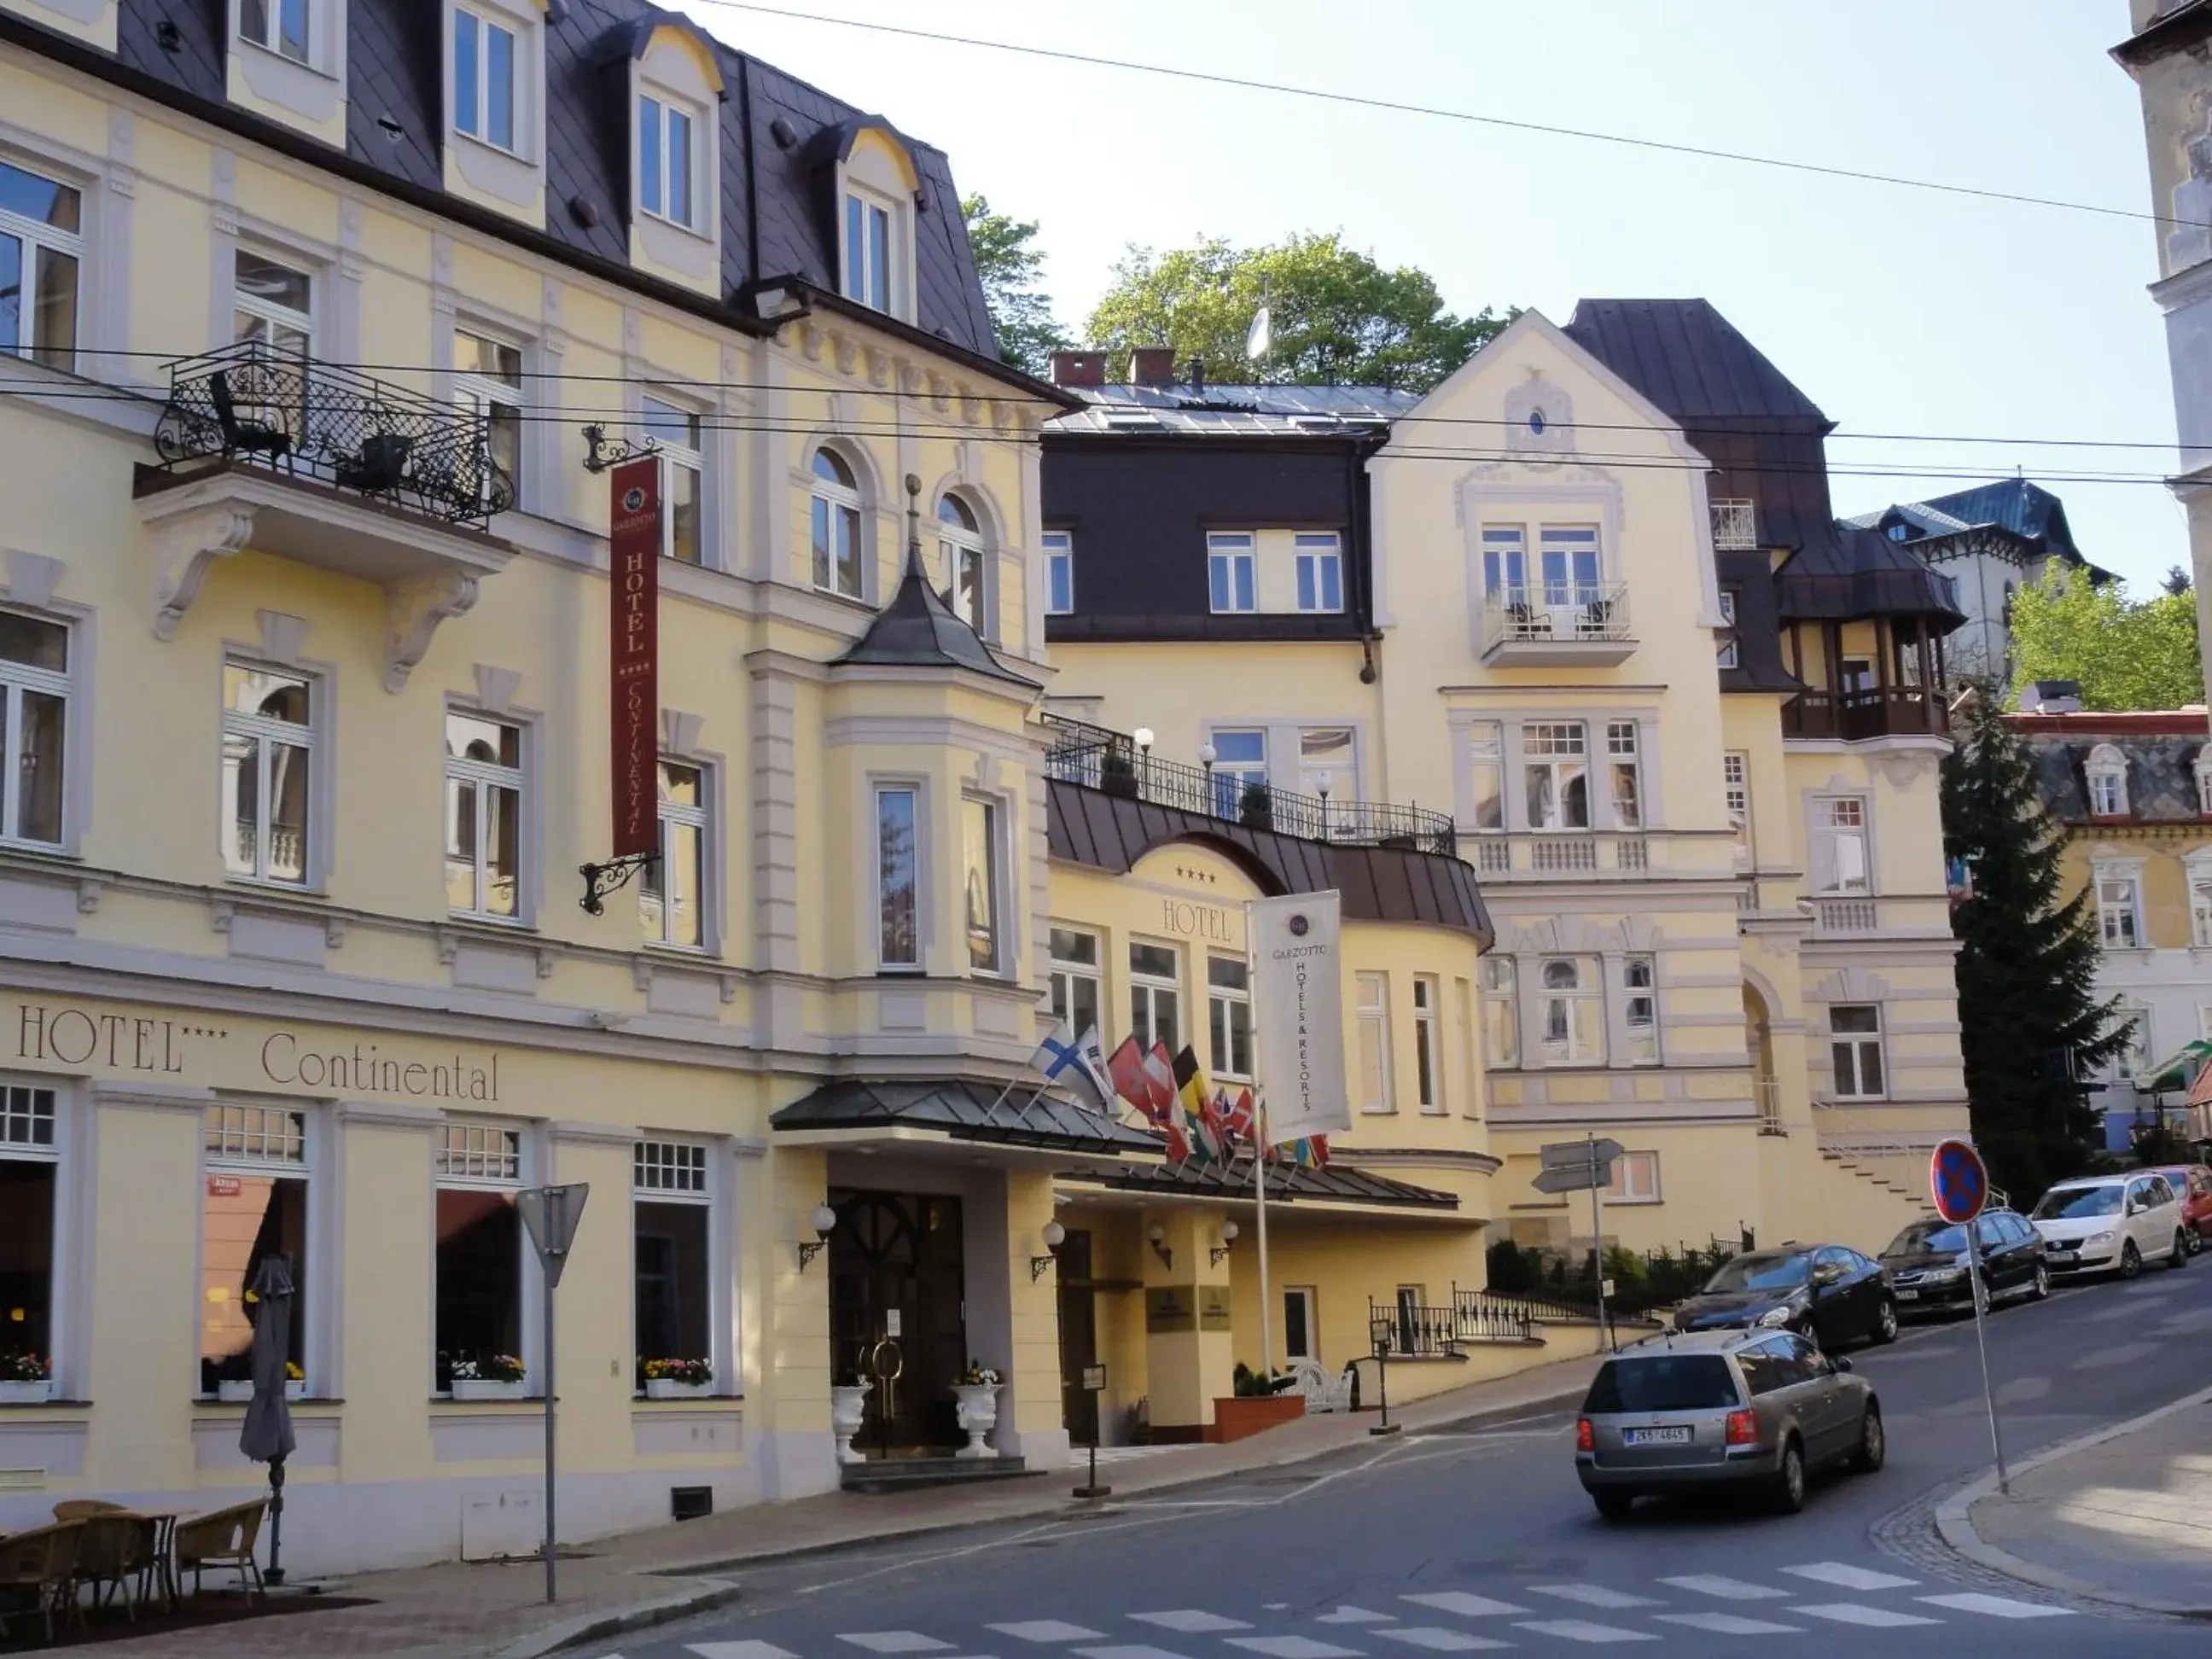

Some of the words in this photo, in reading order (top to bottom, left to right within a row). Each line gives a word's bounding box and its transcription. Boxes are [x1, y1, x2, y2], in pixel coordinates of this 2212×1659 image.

[626, 554, 645, 652] HOTEL
[627, 682, 643, 835] CONTINENTAL
[1163, 900, 1231, 942] HOTEL
[1295, 962, 1307, 1022] HOTELS
[18, 1005, 182, 1074] HOTEL
[261, 1033, 499, 1103] Continental
[1298, 1039, 1312, 1112] RESORTS
